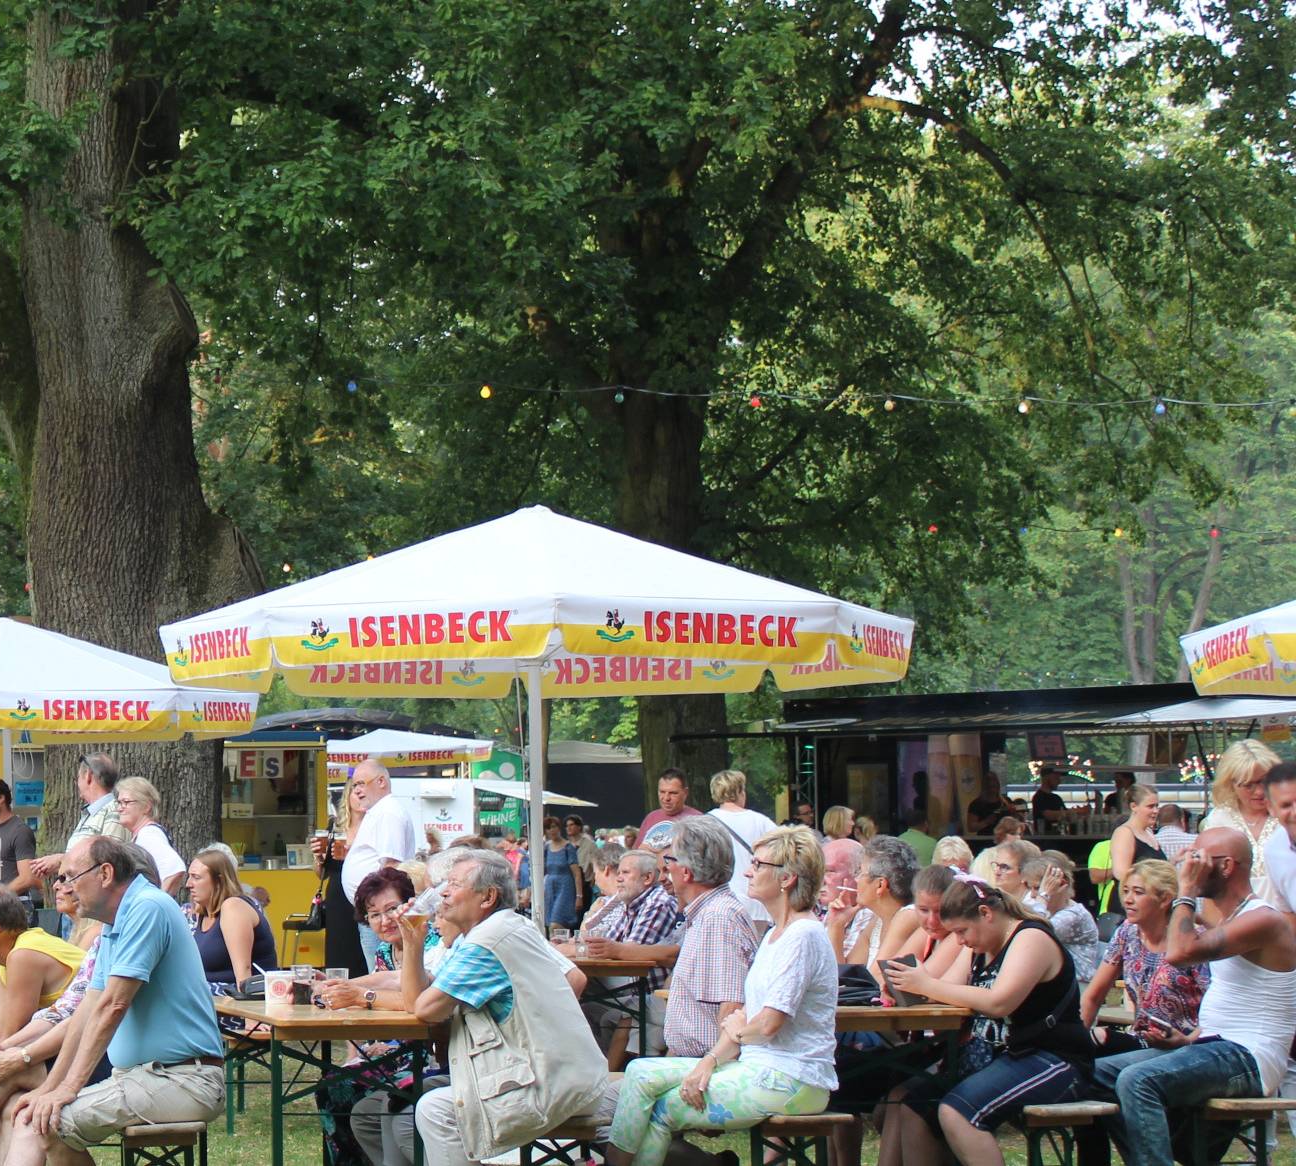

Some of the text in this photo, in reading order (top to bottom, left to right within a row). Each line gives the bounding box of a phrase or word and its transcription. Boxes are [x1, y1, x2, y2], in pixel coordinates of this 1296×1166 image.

[189, 626, 250, 663] ISENBECK
[348, 610, 512, 648] ISENBECK
[644, 611, 798, 648] ISENBECK
[863, 624, 905, 661] ISENBECK
[1203, 625, 1250, 669] ISENBECK
[43, 700, 150, 721] ISENBECK
[203, 701, 251, 722] ISENBECK
[327, 752, 368, 763] SENBECK
[409, 750, 454, 761] ISENBECK
